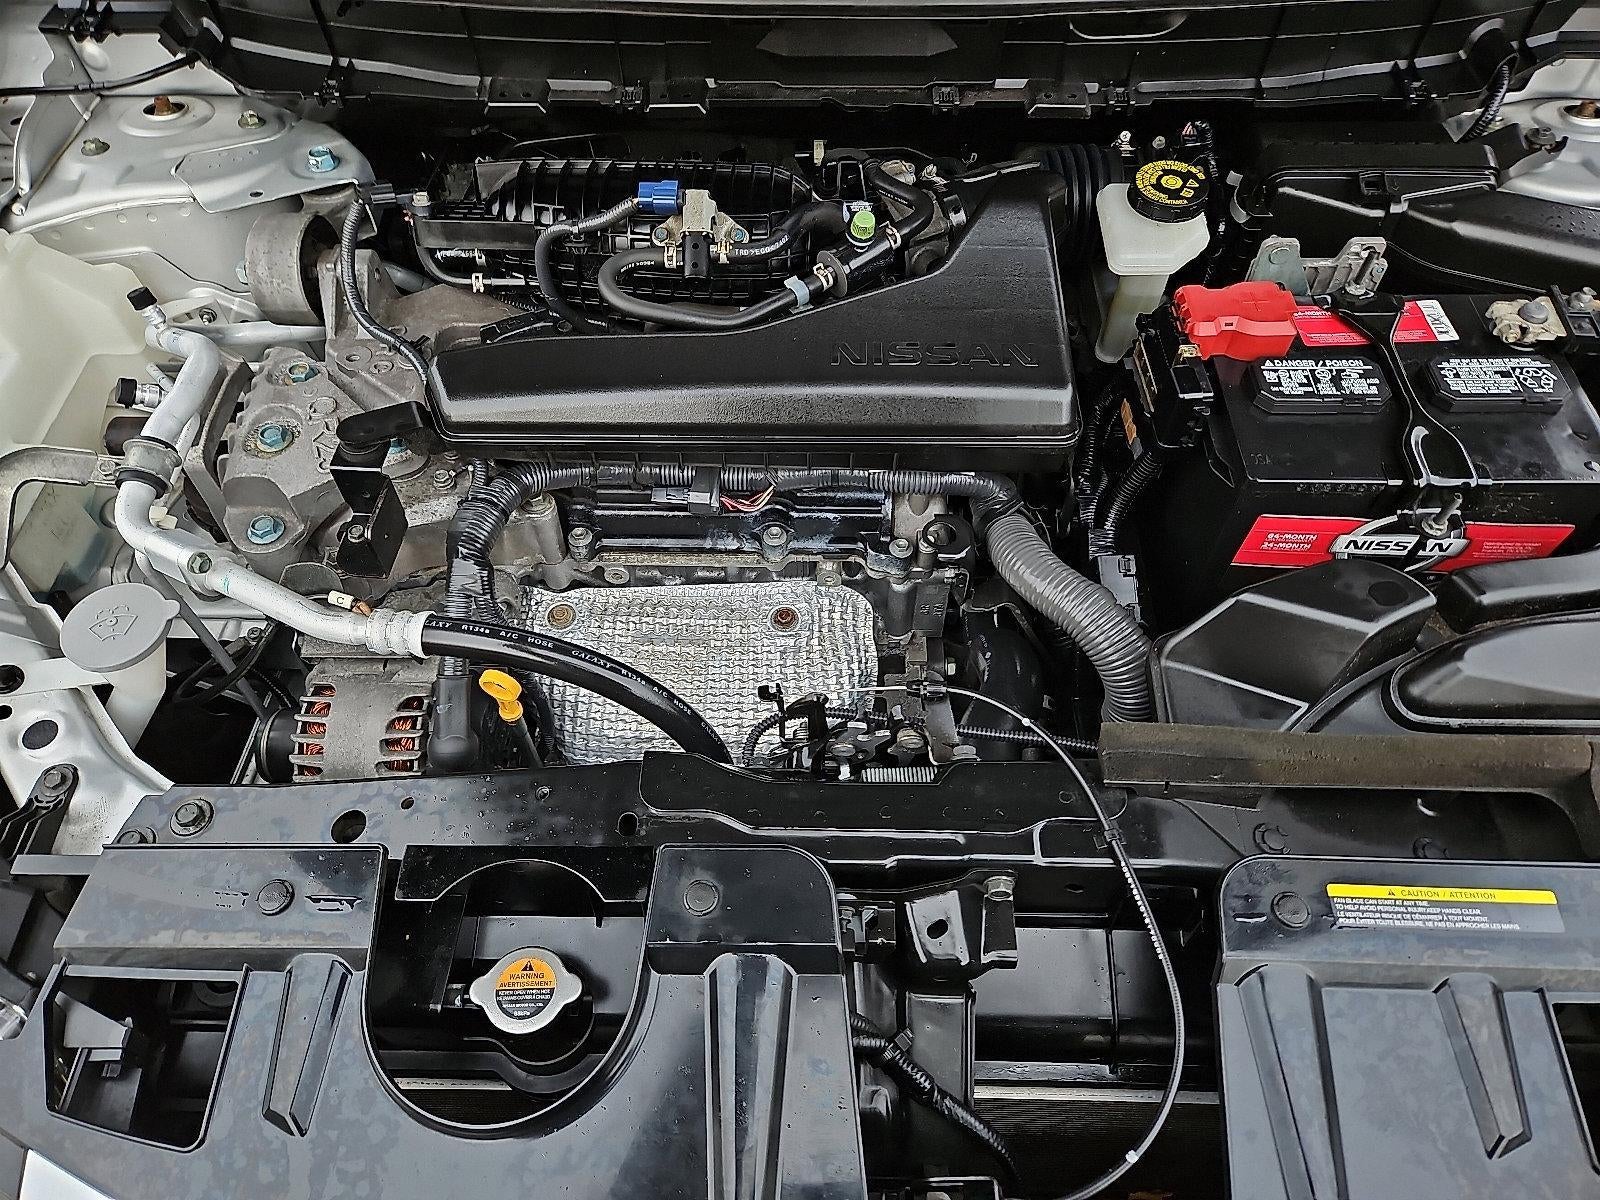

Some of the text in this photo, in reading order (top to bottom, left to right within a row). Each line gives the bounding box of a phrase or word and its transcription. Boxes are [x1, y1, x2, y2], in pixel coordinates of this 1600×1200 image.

[830, 342, 1039, 366] NISSAN
[1343, 539, 1454, 553] NISSN
[336, 596, 345, 605] C
[462, 625, 490, 634] R134a
[500, 631, 519, 639] A/C
[528, 637, 554, 648] HOSE
[572, 650, 612, 669] GALAXY
[653, 686, 668, 698] A/C
[673, 699, 692, 716] HOSE
[1401, 890, 1440, 898] CAUTION
